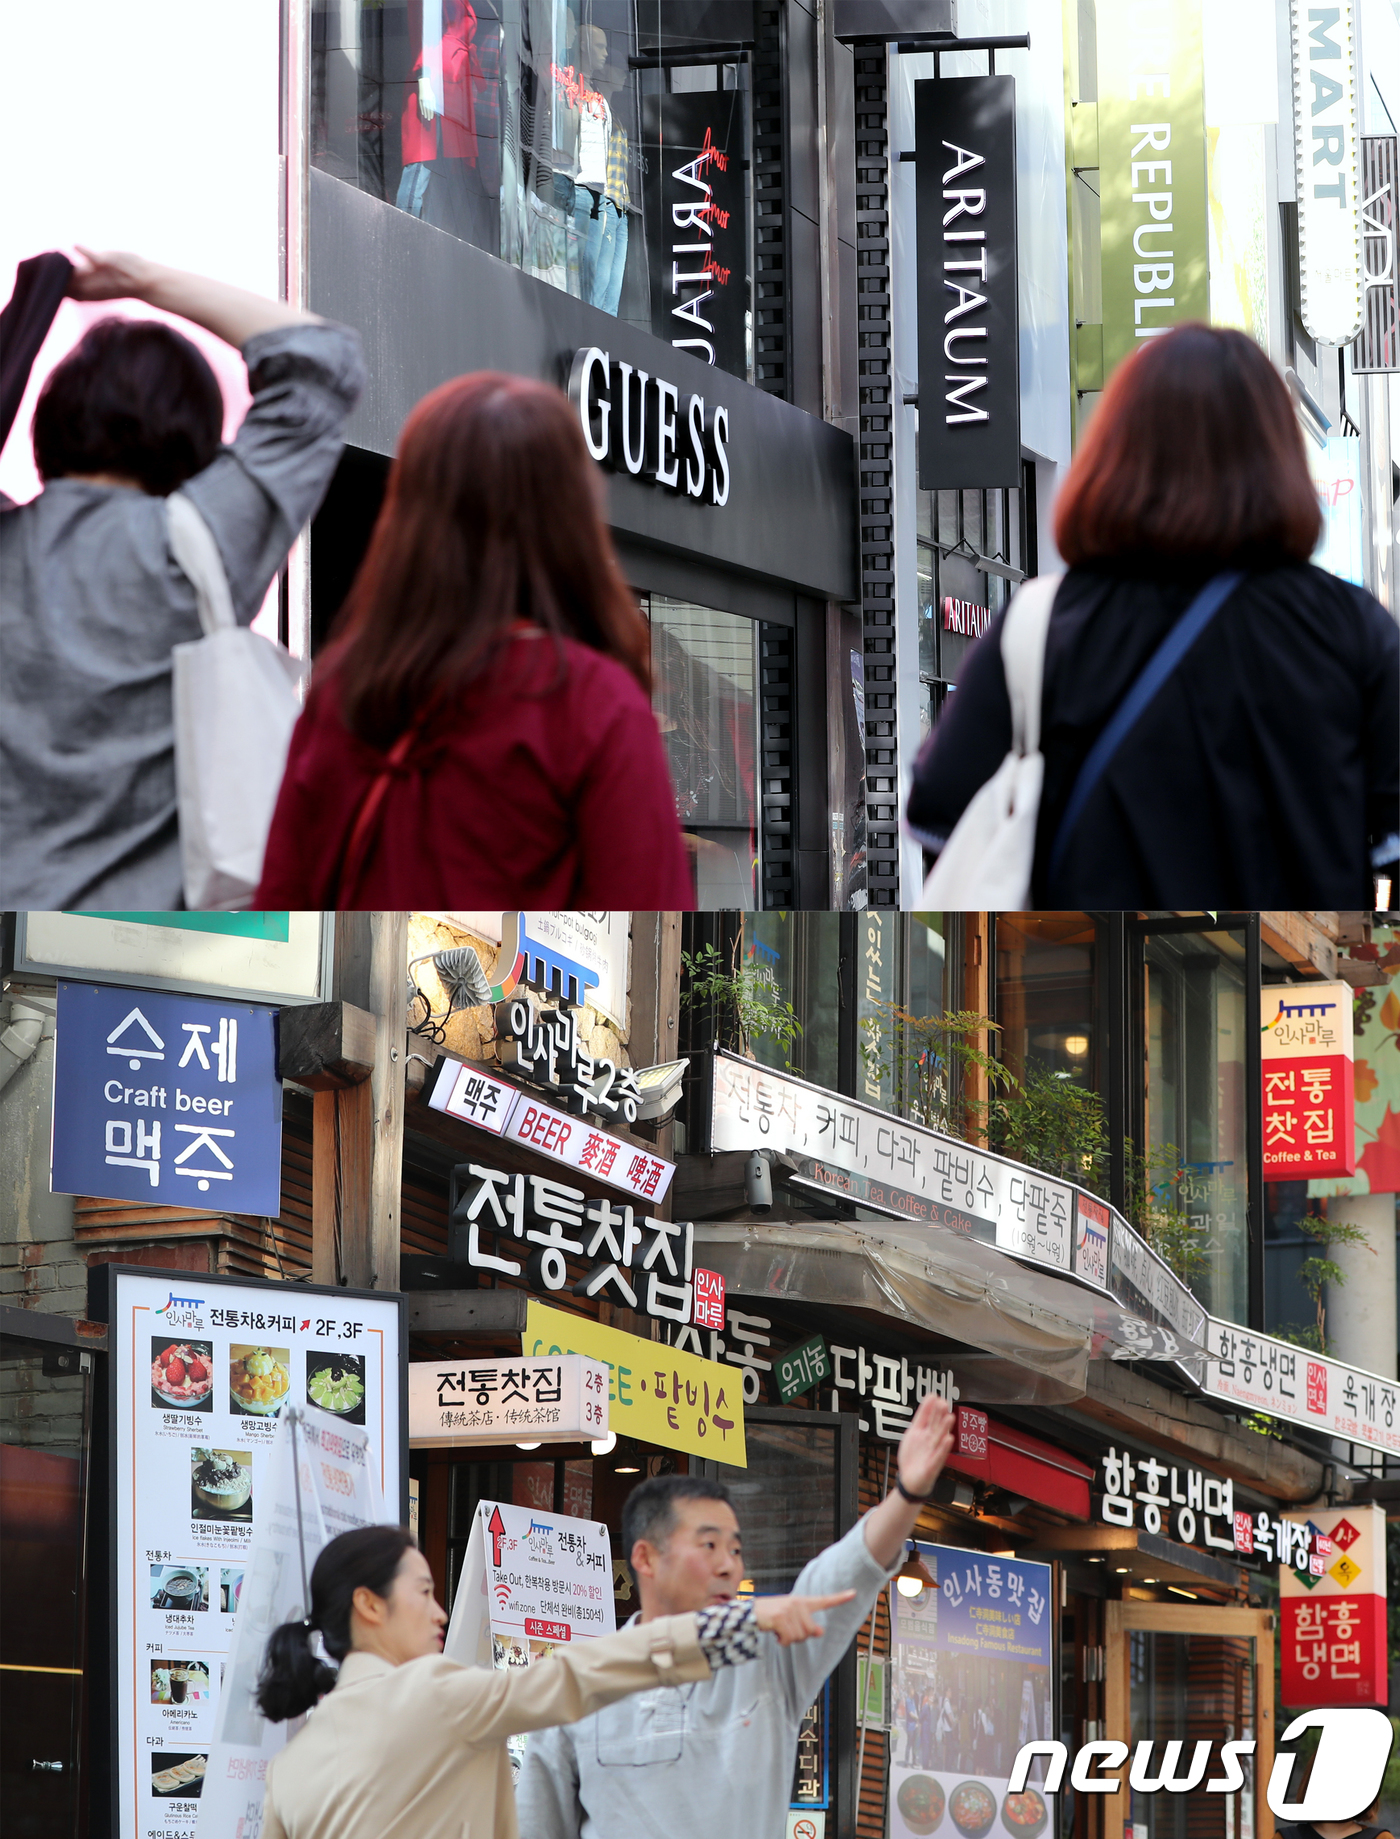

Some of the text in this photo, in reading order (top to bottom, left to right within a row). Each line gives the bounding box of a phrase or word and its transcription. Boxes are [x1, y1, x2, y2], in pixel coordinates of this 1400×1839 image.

[1308, 7, 1346, 209] MART
[1130, 123, 1175, 354] REPUBLI
[942, 140, 990, 424] ARITAUM
[580, 347, 730, 507] GUESS
[106, 1006, 238, 1083] 수제
[1274, 1020, 1337, 1048] 인사마루
[104, 1079, 234, 1116] Craft beer
[463, 1076, 502, 1121] 맥주
[1265, 1068, 1332, 1106] 전통
[1265, 1108, 1334, 1146] 찻집
[105, 1119, 236, 1191] 맥주
[517, 1107, 665, 1198] BEER 麥酒 啤酒
[1263, 1149, 1337, 1164] Coffee & Tea
[816, 1104, 868, 1168] 커피,
[877, 1127, 926, 1190] 다과,
[933, 1148, 1001, 1217] 팥빙수,
[1010, 1177, 1067, 1239] 단팥죽
[815, 1162, 858, 1194] Korean
[890, 1191, 927, 1218] Coffee
[930, 1205, 940, 1221] &
[943, 1209, 972, 1234] Cake
[466, 1163, 695, 1324] 전통찻집
[697, 1271, 724, 1301] 인사
[166, 1308, 363, 1339] 인사마루 전통차&커피 2F,3F
[696, 1301, 723, 1328] 마루
[437, 1366, 562, 1407] 전통찻집
[586, 1370, 604, 1394] 2층
[782, 1345, 826, 1397] 유기농
[1219, 1330, 1296, 1399] 함흥냉면
[1342, 1375, 1396, 1429] 육개장
[162, 1413, 203, 1426] 생딸기빙수
[586, 1402, 604, 1425] 3층
[654, 1371, 735, 1441] 팥빙수
[1102, 1446, 1312, 1570] 함흥냉면 육개장
[146, 1550, 171, 1561] 전통차
[528, 1536, 554, 1558] 인사마루
[558, 1532, 586, 1554] 전통차
[576, 1551, 606, 1573] & 커피
[492, 1570, 603, 1600] Take Out, 한복착용 방문시 20% 할인
[165, 1614, 195, 1624] 냉대추차
[540, 1600, 560, 1616] 단체석
[1294, 1601, 1361, 1640] 함흥
[146, 1643, 163, 1653] 커피
[529, 1621, 567, 1640] 시즌 스페셜
[947, 1633, 979, 1650] Insadong
[980, 1637, 1006, 1651] Famous
[1006, 1641, 1042, 1657] Restaurant
[1295, 1641, 1361, 1680] 냉면
[162, 1709, 198, 1719] 아메리카노
[146, 1737, 164, 1746] 다과
